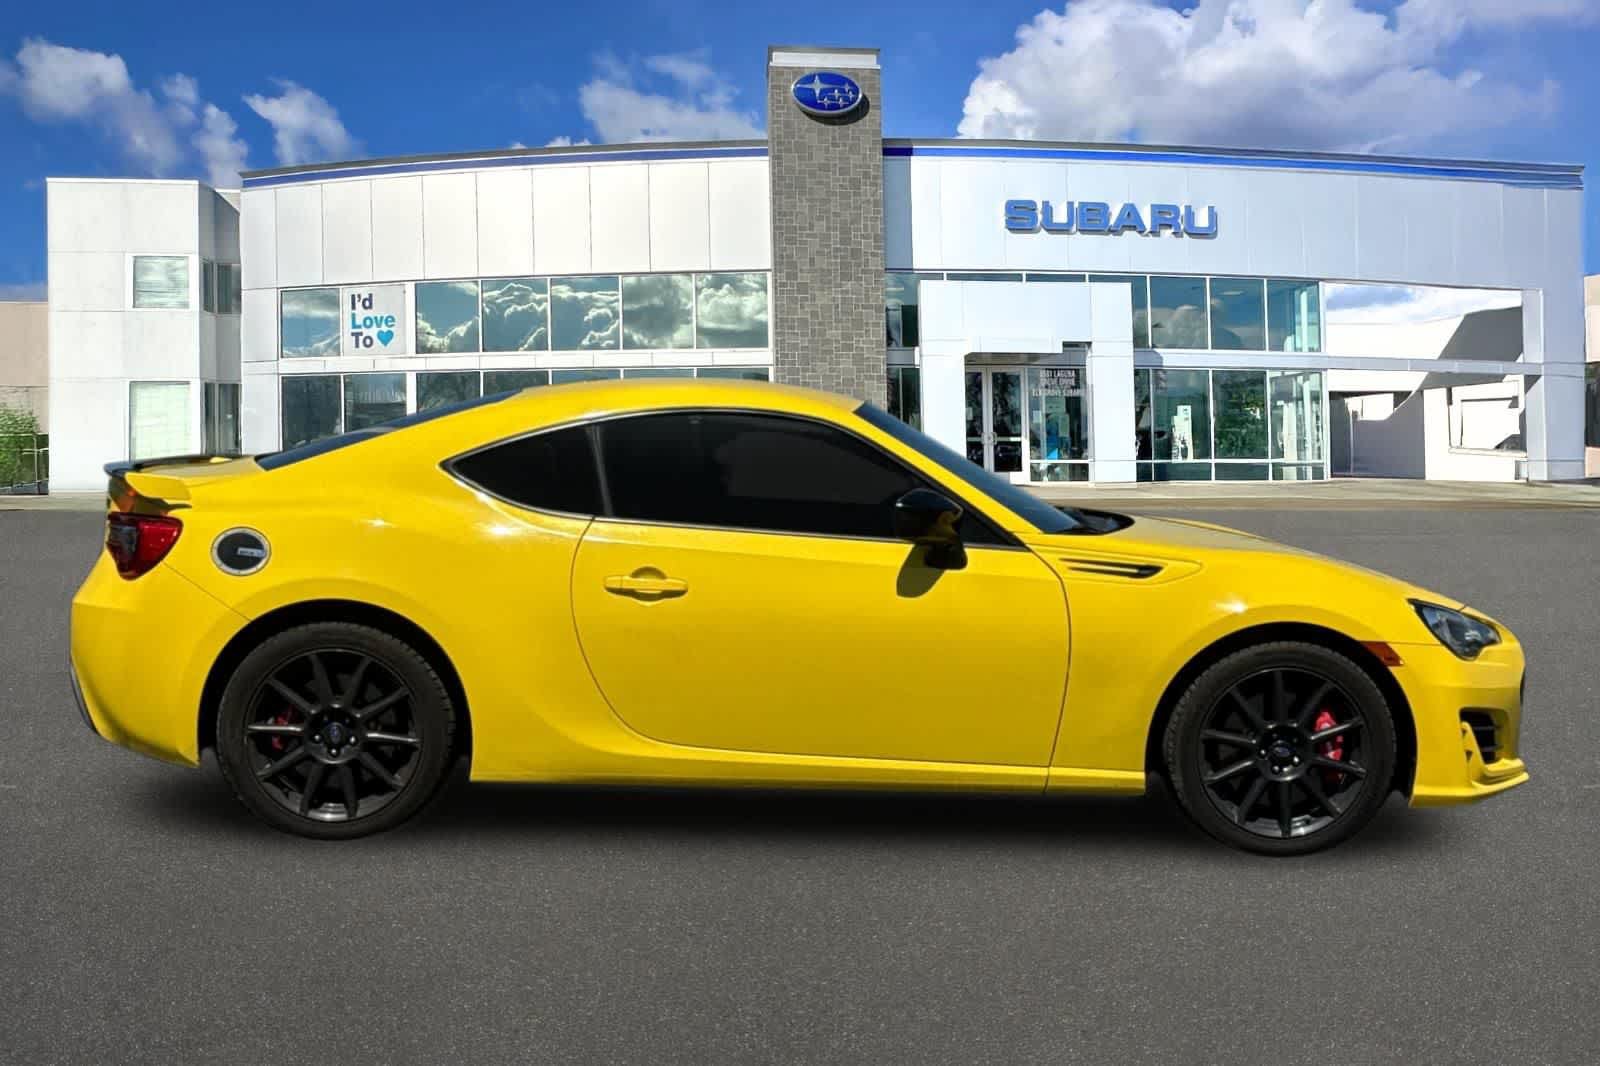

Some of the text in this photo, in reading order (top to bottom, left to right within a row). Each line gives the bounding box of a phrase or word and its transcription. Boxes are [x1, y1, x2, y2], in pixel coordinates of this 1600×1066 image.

[1004, 199, 1217, 237] SUBARU
[351, 293, 373, 310] I'd
[351, 312, 396, 329] Love
[351, 331, 374, 349] To
